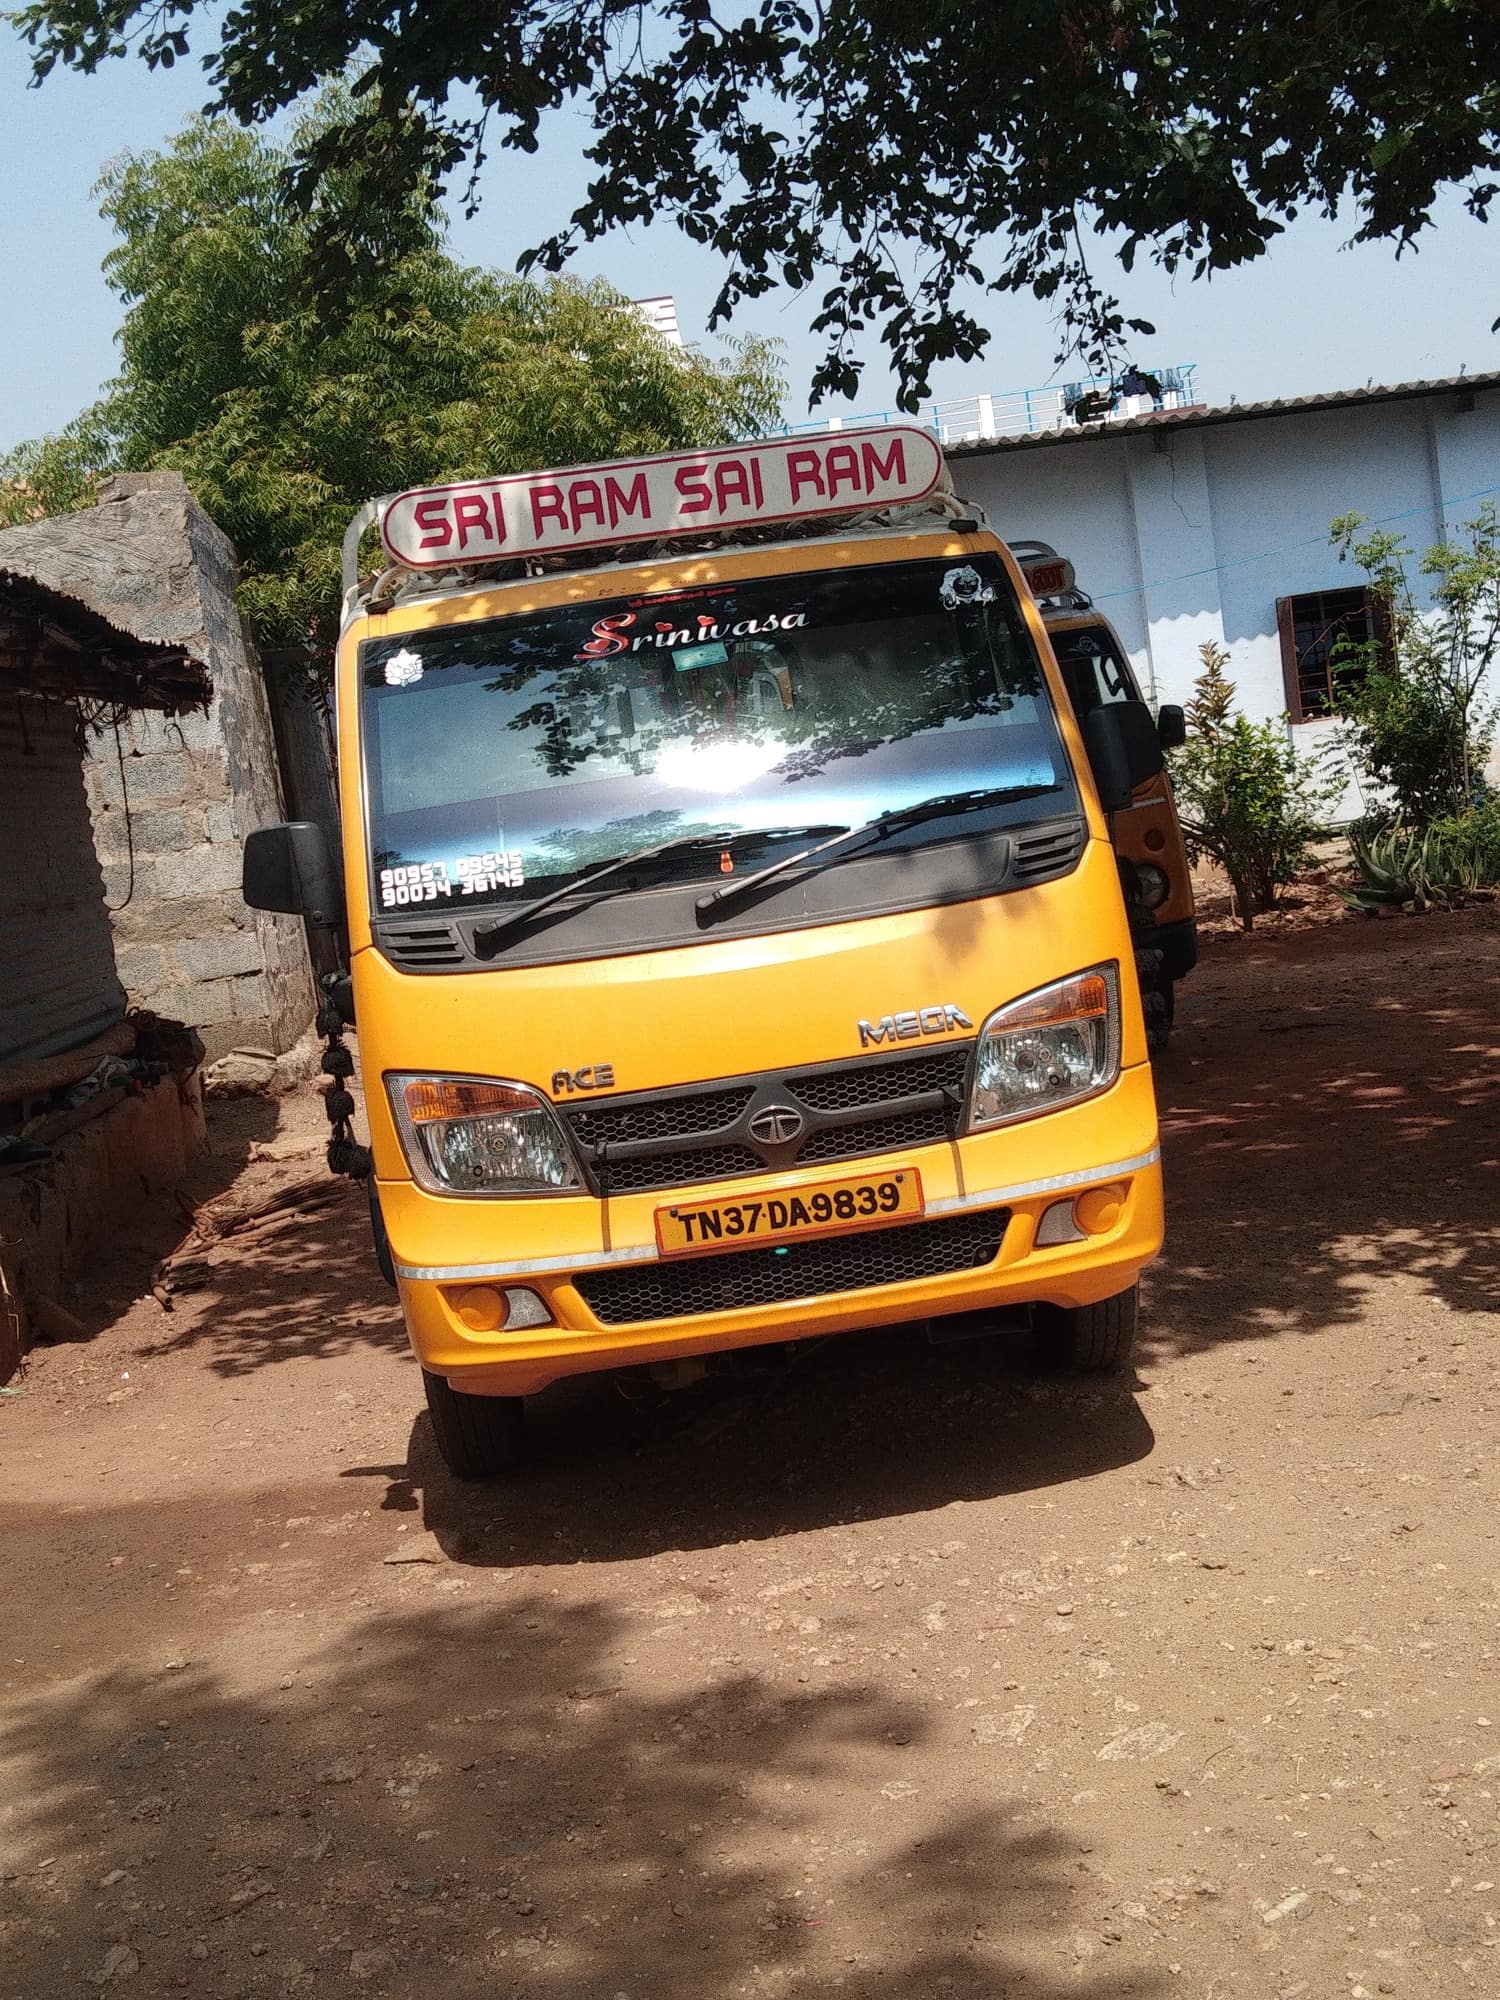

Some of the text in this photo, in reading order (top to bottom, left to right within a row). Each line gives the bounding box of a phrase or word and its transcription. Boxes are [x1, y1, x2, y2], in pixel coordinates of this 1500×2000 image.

[413, 438, 907, 551] SRI RAM SAI RAM
[573, 612, 810, 660] Srinivasa
[380, 861, 448, 889] 90957
[382, 879, 452, 907] 90034
[857, 1003, 974, 1048] MEGA
[551, 1062, 616, 1096] ACE
